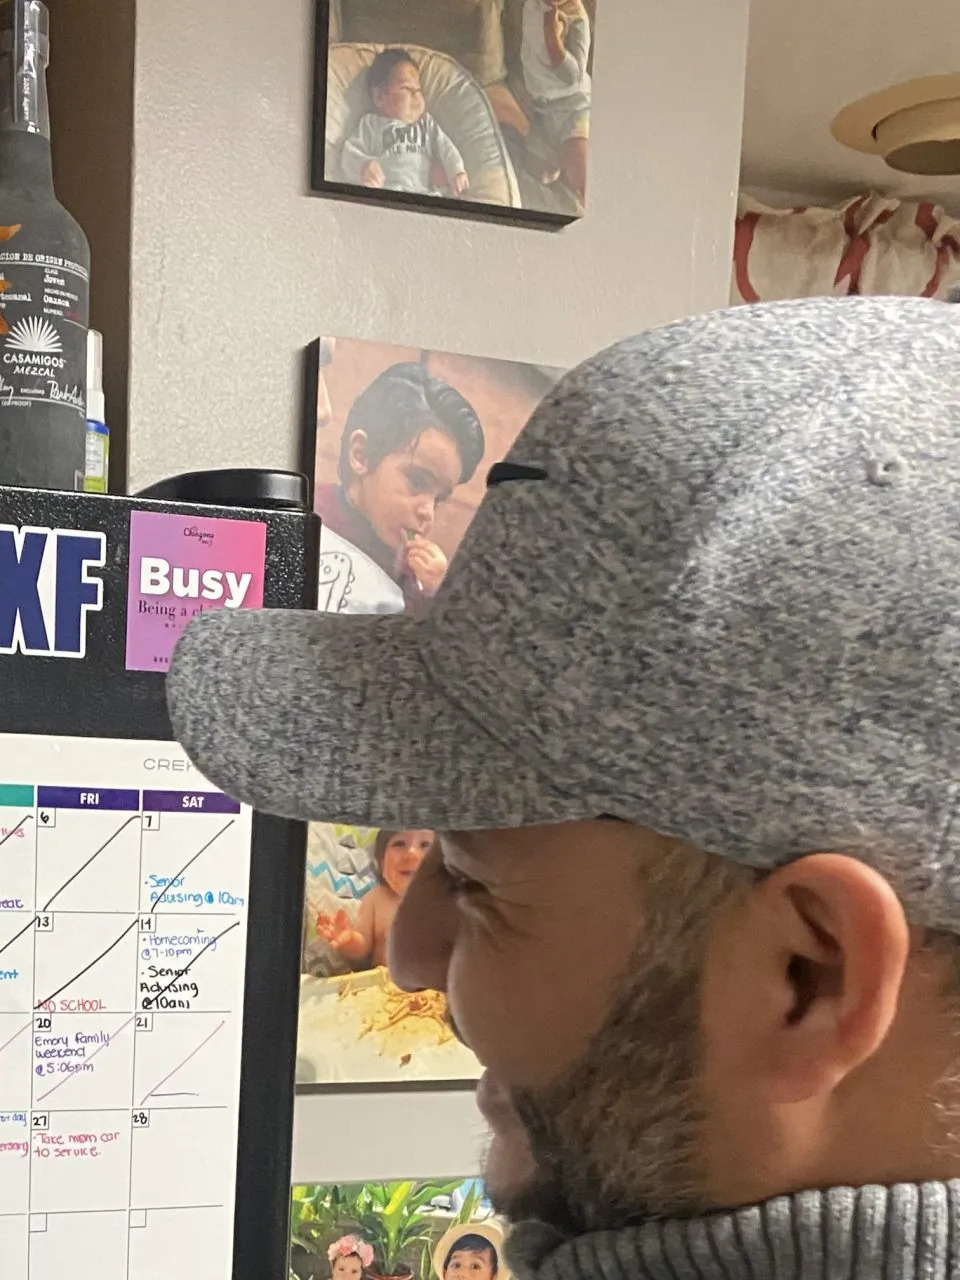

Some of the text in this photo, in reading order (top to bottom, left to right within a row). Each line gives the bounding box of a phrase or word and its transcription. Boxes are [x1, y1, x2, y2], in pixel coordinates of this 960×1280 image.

[3, 353, 63, 368] CASAMIGOS
[13, 366, 55, 377] MEZCAL
[141, 556, 252, 608] Busy
[139, 600, 176, 620] Being
[181, 608, 186, 616] a
[80, 792, 99, 805] FRI
[182, 796, 204, 808] SAT
[40, 812, 49, 824] 6
[145, 816, 152, 827] 7
[149, 875, 184, 887] Senior
[36, 916, 49, 927] 13
[141, 918, 151, 930] 14
[149, 935, 216, 951] Homecoming
[148, 965, 191, 978] Senior
[38, 999, 107, 1012] NO SCHOOL
[36, 1017, 51, 1029] 20
[136, 1017, 147, 1028] 21
[35, 1037, 68, 1047] Emory
[12, 1113, 26, 1126] day
[32, 1115, 47, 1126] 27
[132, 1113, 148, 1124] 28
[68, 1134, 97, 1143] mom
[100, 1132, 119, 1142] car
[33, 1148, 49, 1157] to
